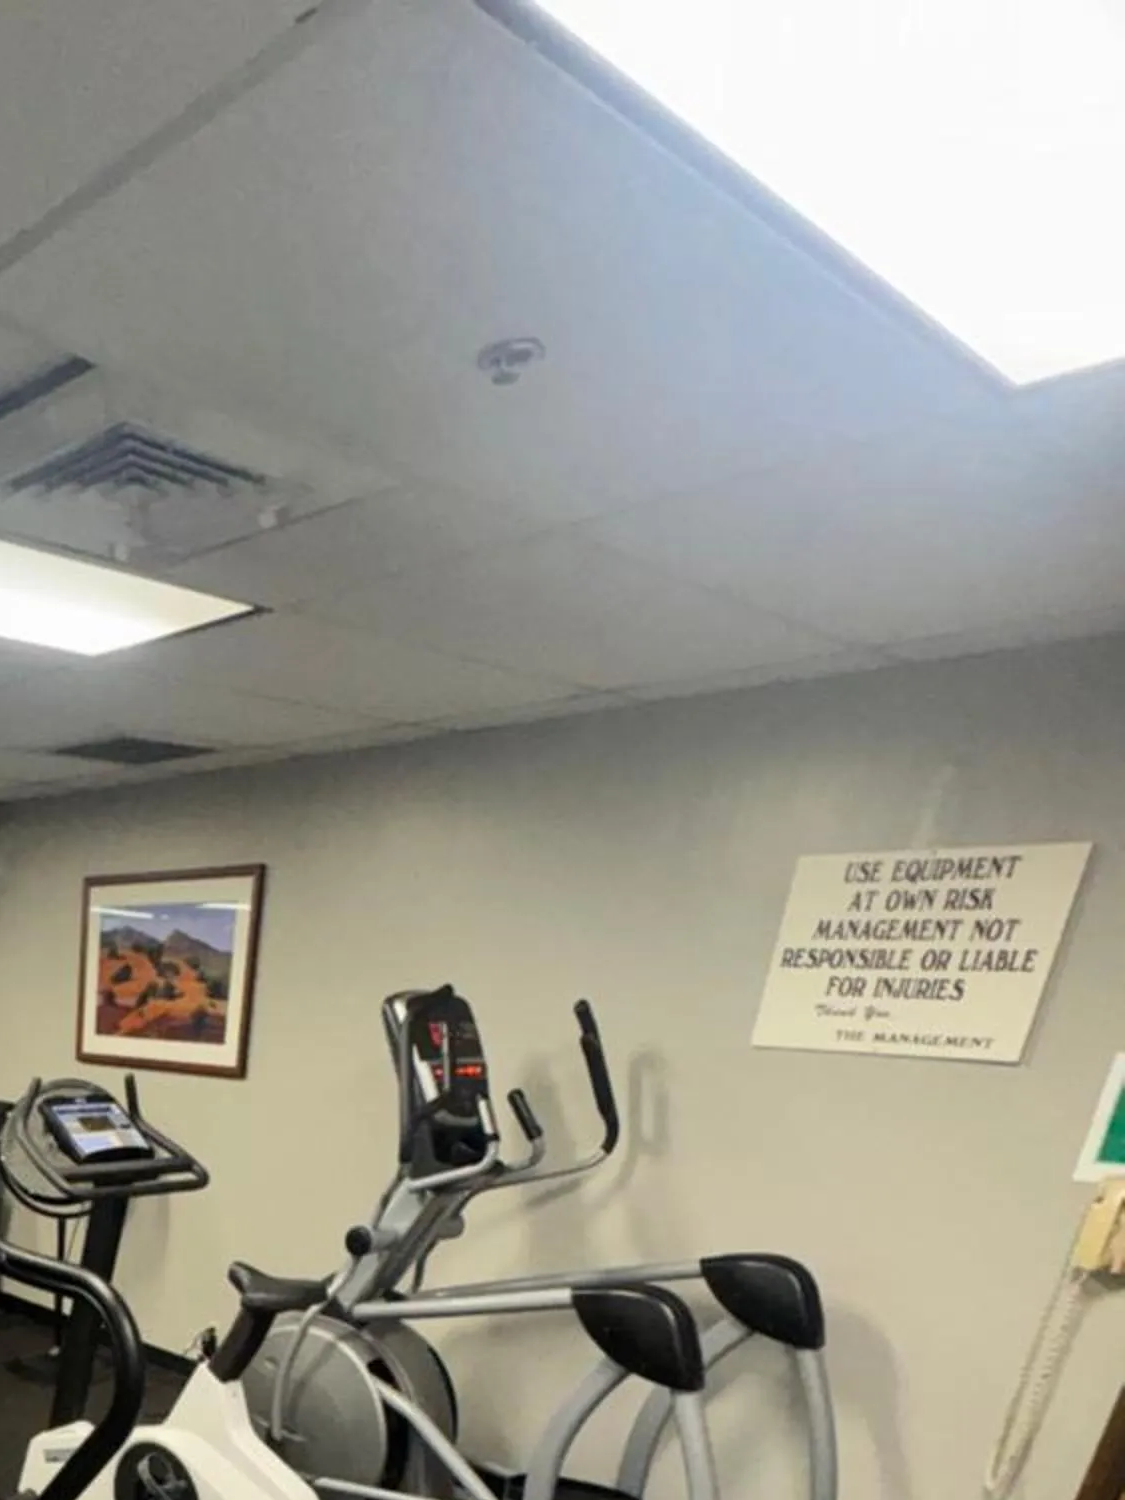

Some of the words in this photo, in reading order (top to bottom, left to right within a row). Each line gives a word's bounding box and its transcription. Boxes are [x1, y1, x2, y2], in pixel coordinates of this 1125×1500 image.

[845, 860, 882, 884] USE
[891, 856, 1022, 880] EQUIPMENT
[848, 891, 878, 912] AT
[885, 889, 939, 912] OWN
[943, 888, 997, 911] RISK
[812, 919, 963, 941] MANAGEMENT
[969, 919, 1022, 941] NOT
[780, 947, 915, 972] RESPONSIBLE
[921, 950, 952, 972] OR
[959, 949, 1038, 972] LIABLE
[825, 976, 867, 998] FOR
[873, 977, 965, 1001] INJURIES
[836, 1029, 865, 1042] THE
[873, 1031, 995, 1049] MANAGEMENT
